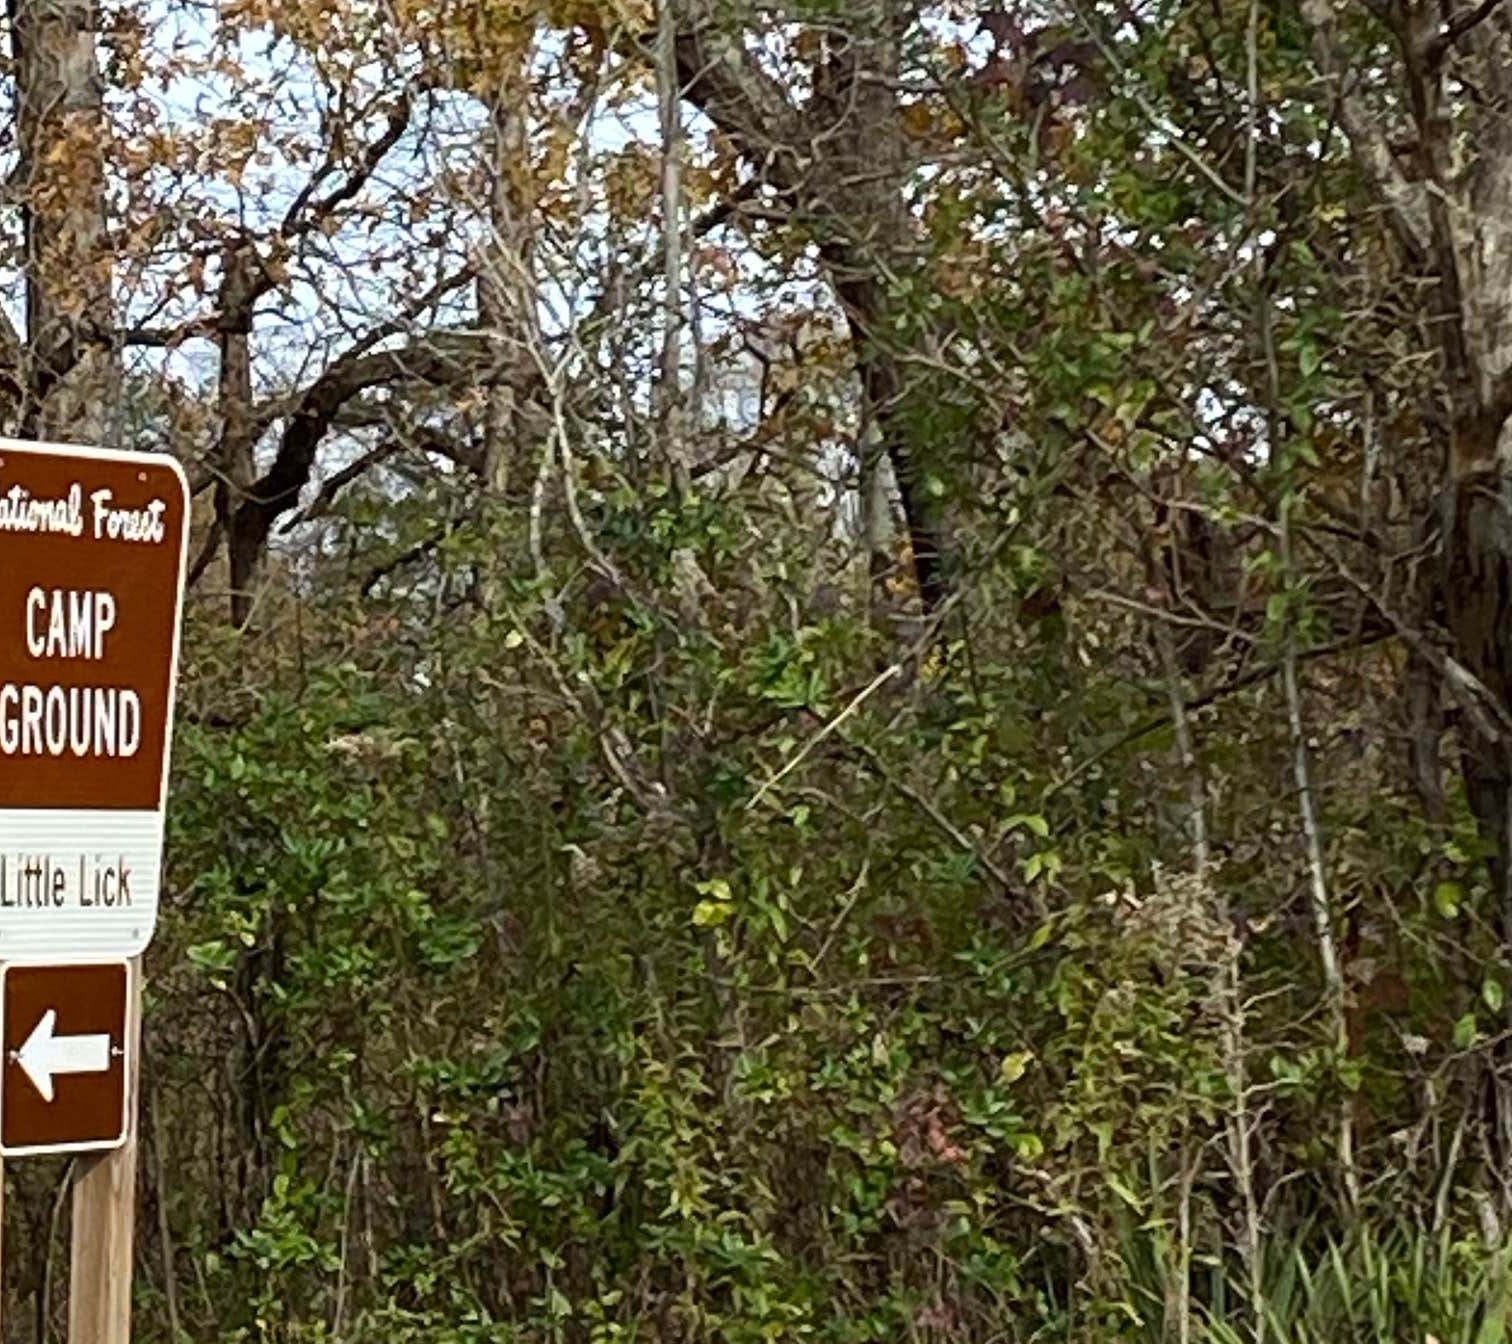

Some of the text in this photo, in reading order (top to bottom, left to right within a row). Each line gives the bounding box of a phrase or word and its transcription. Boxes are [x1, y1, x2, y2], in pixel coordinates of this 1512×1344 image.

[91, 489, 167, 543] Forest
[26, 587, 116, 659] CAMP
[0, 853, 132, 908] Little Lick
